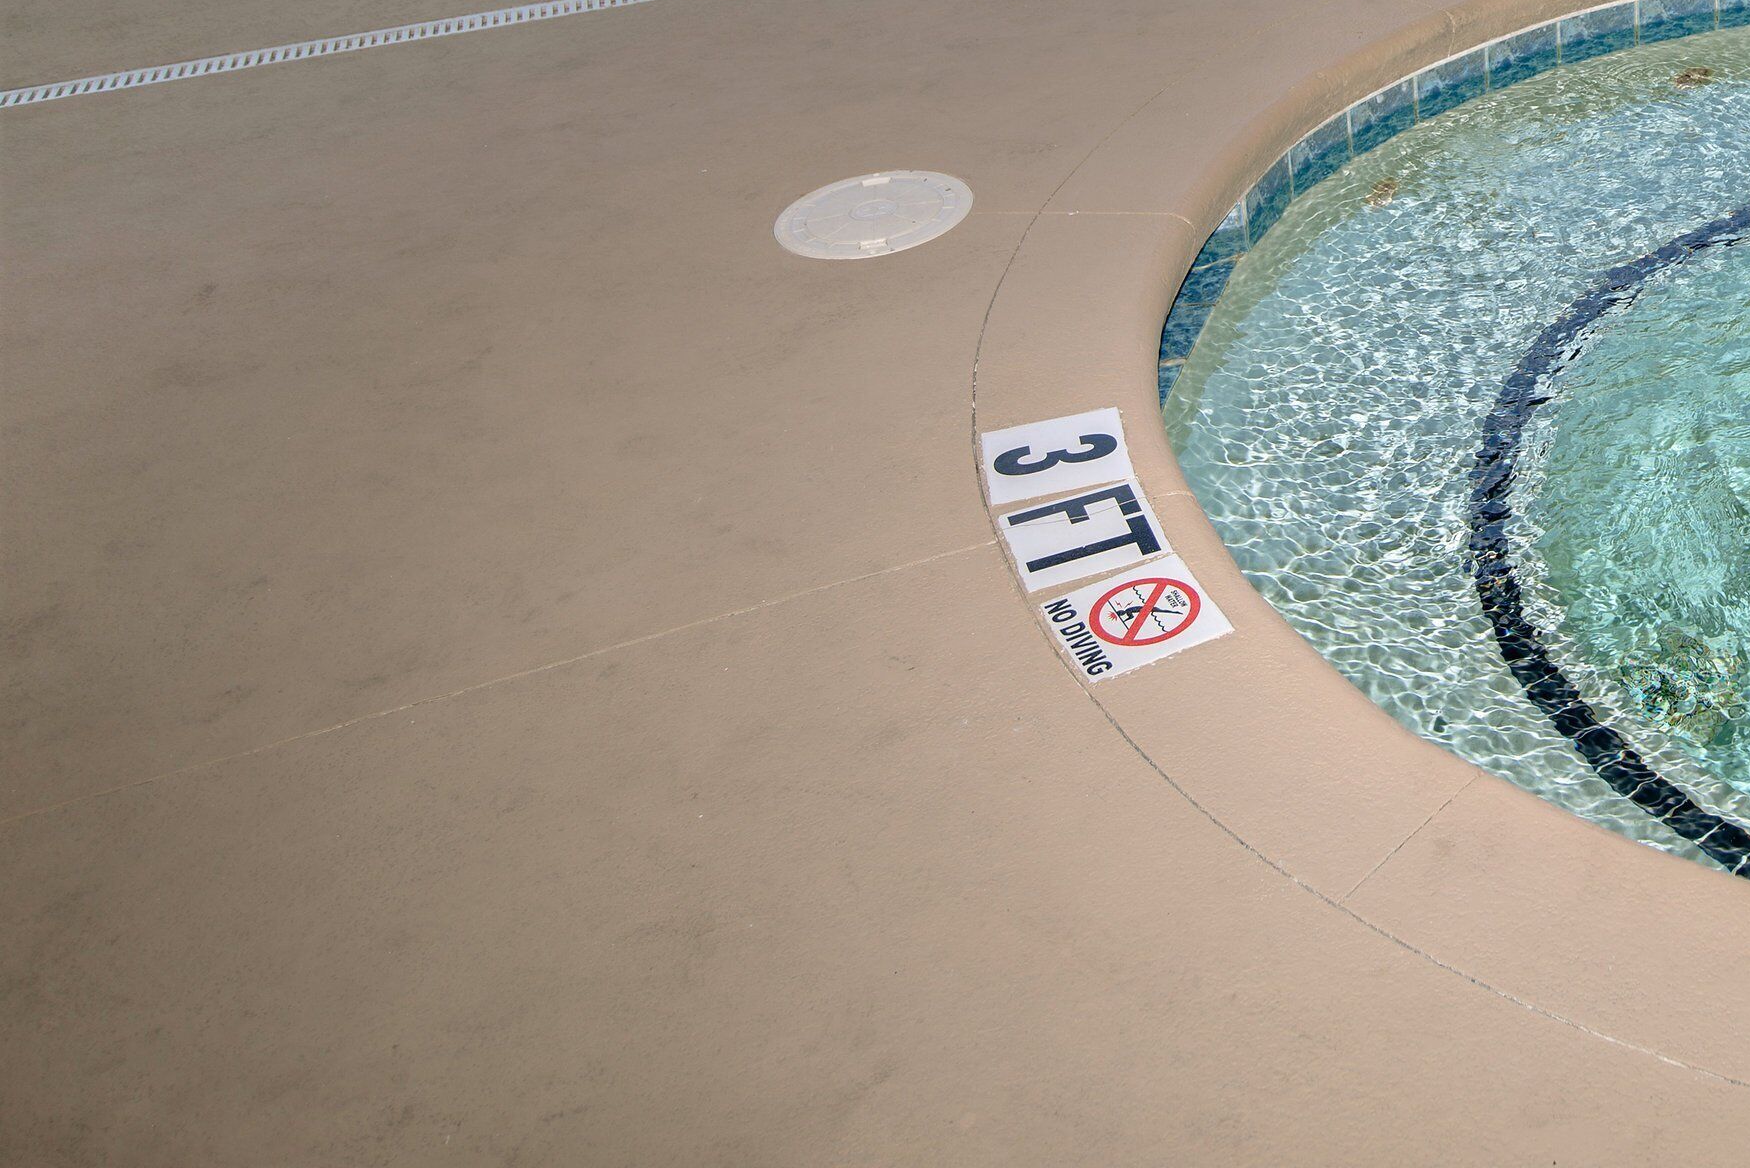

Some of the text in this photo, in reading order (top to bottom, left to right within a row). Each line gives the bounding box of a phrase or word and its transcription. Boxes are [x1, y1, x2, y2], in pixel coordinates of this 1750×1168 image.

[993, 433, 1162, 573] 3 FT
[1044, 598, 1113, 676] NO DIVING
